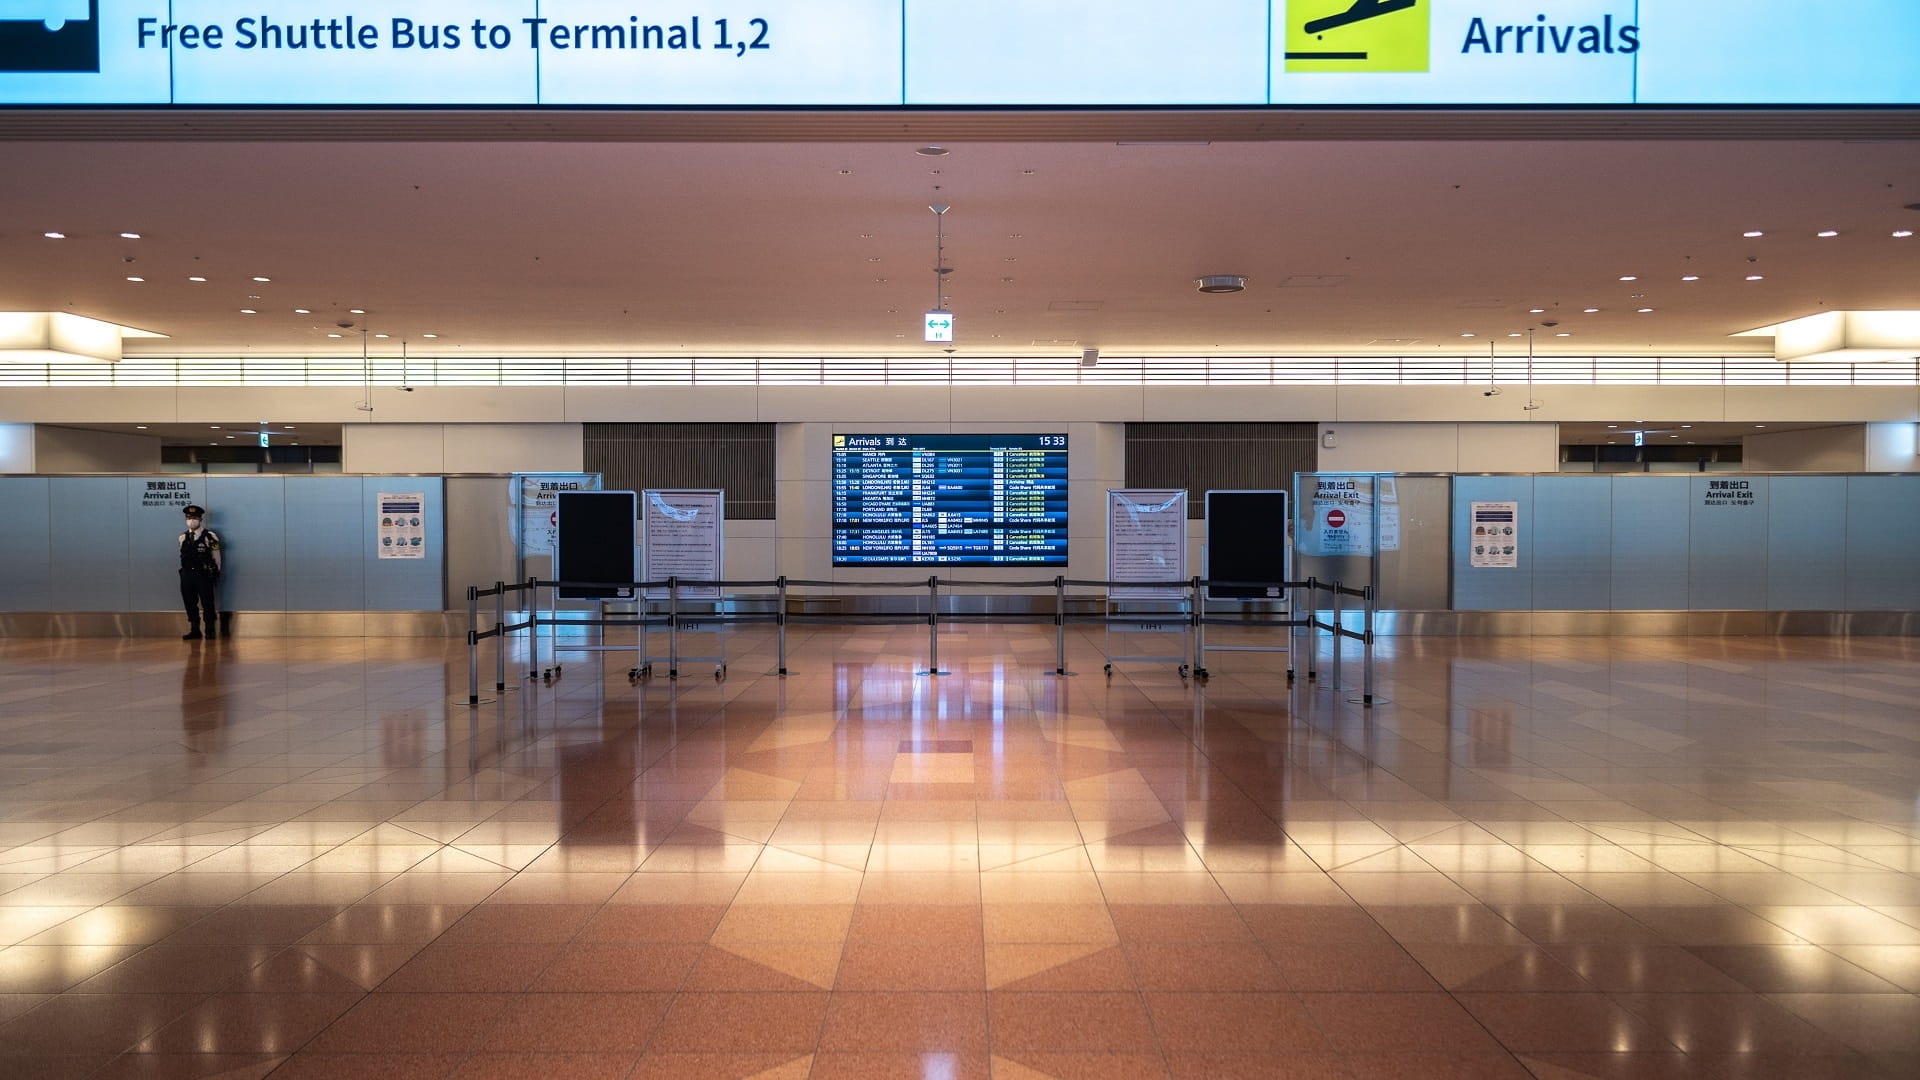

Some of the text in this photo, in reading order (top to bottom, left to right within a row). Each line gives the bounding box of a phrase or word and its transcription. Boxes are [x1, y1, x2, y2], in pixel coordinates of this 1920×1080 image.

[138, 16, 770, 58] Free Shuttle Bus to Terminal 1,2
[1461, 14, 1640, 54] Arrivals
[848, 437, 881, 446] Arrivals
[146, 482, 186, 490] 到着出口
[540, 482, 578, 490] 到着出口
[1317, 482, 1355, 490] 到着出口
[1709, 480, 1749, 489] 到着出口
